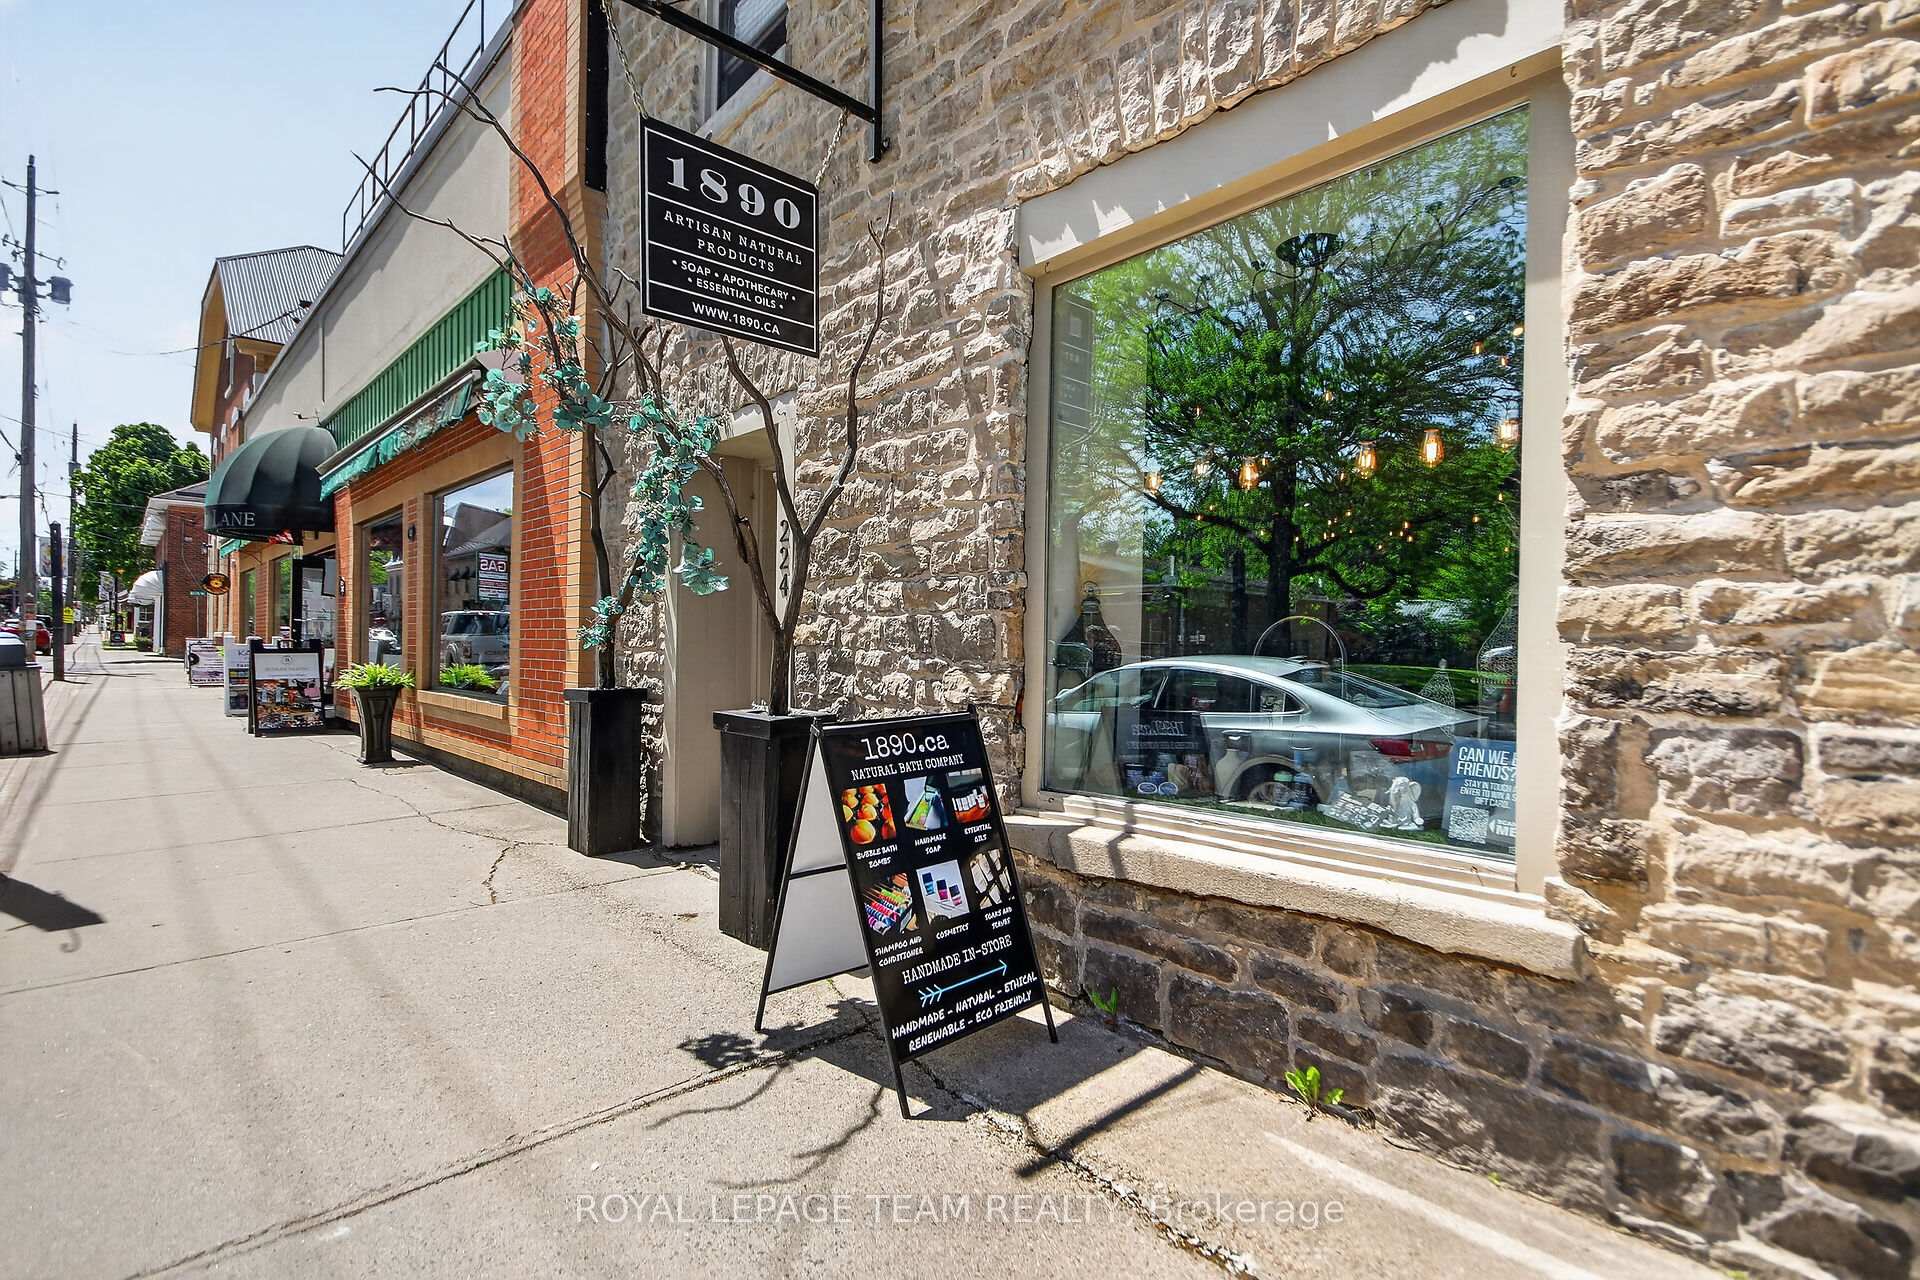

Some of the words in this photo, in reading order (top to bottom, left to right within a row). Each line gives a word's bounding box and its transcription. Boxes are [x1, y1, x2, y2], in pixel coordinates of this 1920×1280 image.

[666, 157, 801, 229] 1890
[664, 210, 731, 241] ARTISAN
[739, 234, 802, 265] NATURAL
[697, 239, 774, 272] PRODUCTS
[681, 260, 711, 277] SOAP
[722, 273, 789, 300] APOTHECARY
[696, 278, 752, 302] ESSENTIAL
[754, 295, 776, 309] OILS
[692, 301, 781, 335] WWW.1890.CA
[779, 520, 790, 597] 224
[860, 733, 950, 760] 1890.ca
[1458, 746, 1485, 762] CAN
[1489, 749, 1510, 765] WE
[851, 763, 898, 781] NATURAL
[900, 758, 924, 774] BATH
[925, 754, 965, 769] COMPANY
[1456, 761, 1517, 781] FRIENDS?
[914, 833, 947, 846] HANDMADE
[964, 823, 992, 835] ESSENTIAL
[974, 834, 987, 843] OILS
[856, 847, 881, 860] BUBBLE
[882, 844, 898, 854] BATH
[868, 857, 891, 869] BOMBS
[925, 845, 942, 854] SOAP
[936, 923, 969, 940] COSMETICS
[874, 941, 908, 957] SHAMPOO
[909, 936, 922, 948] AND
[878, 947, 923, 967] CONDITIONER
[902, 953, 961, 984] HANDMADE
[963, 934, 1013, 963] IN-STORE
[892, 1008, 945, 1040] HANDMADE
[955, 987, 995, 1013] NATURAL
[1004, 972, 1038, 993] ETHICAL
[909, 1018, 966, 1053] RENEWABLE
[975, 1010, 993, 1023] ECO
[995, 990, 1032, 1015] FRIENDLY
